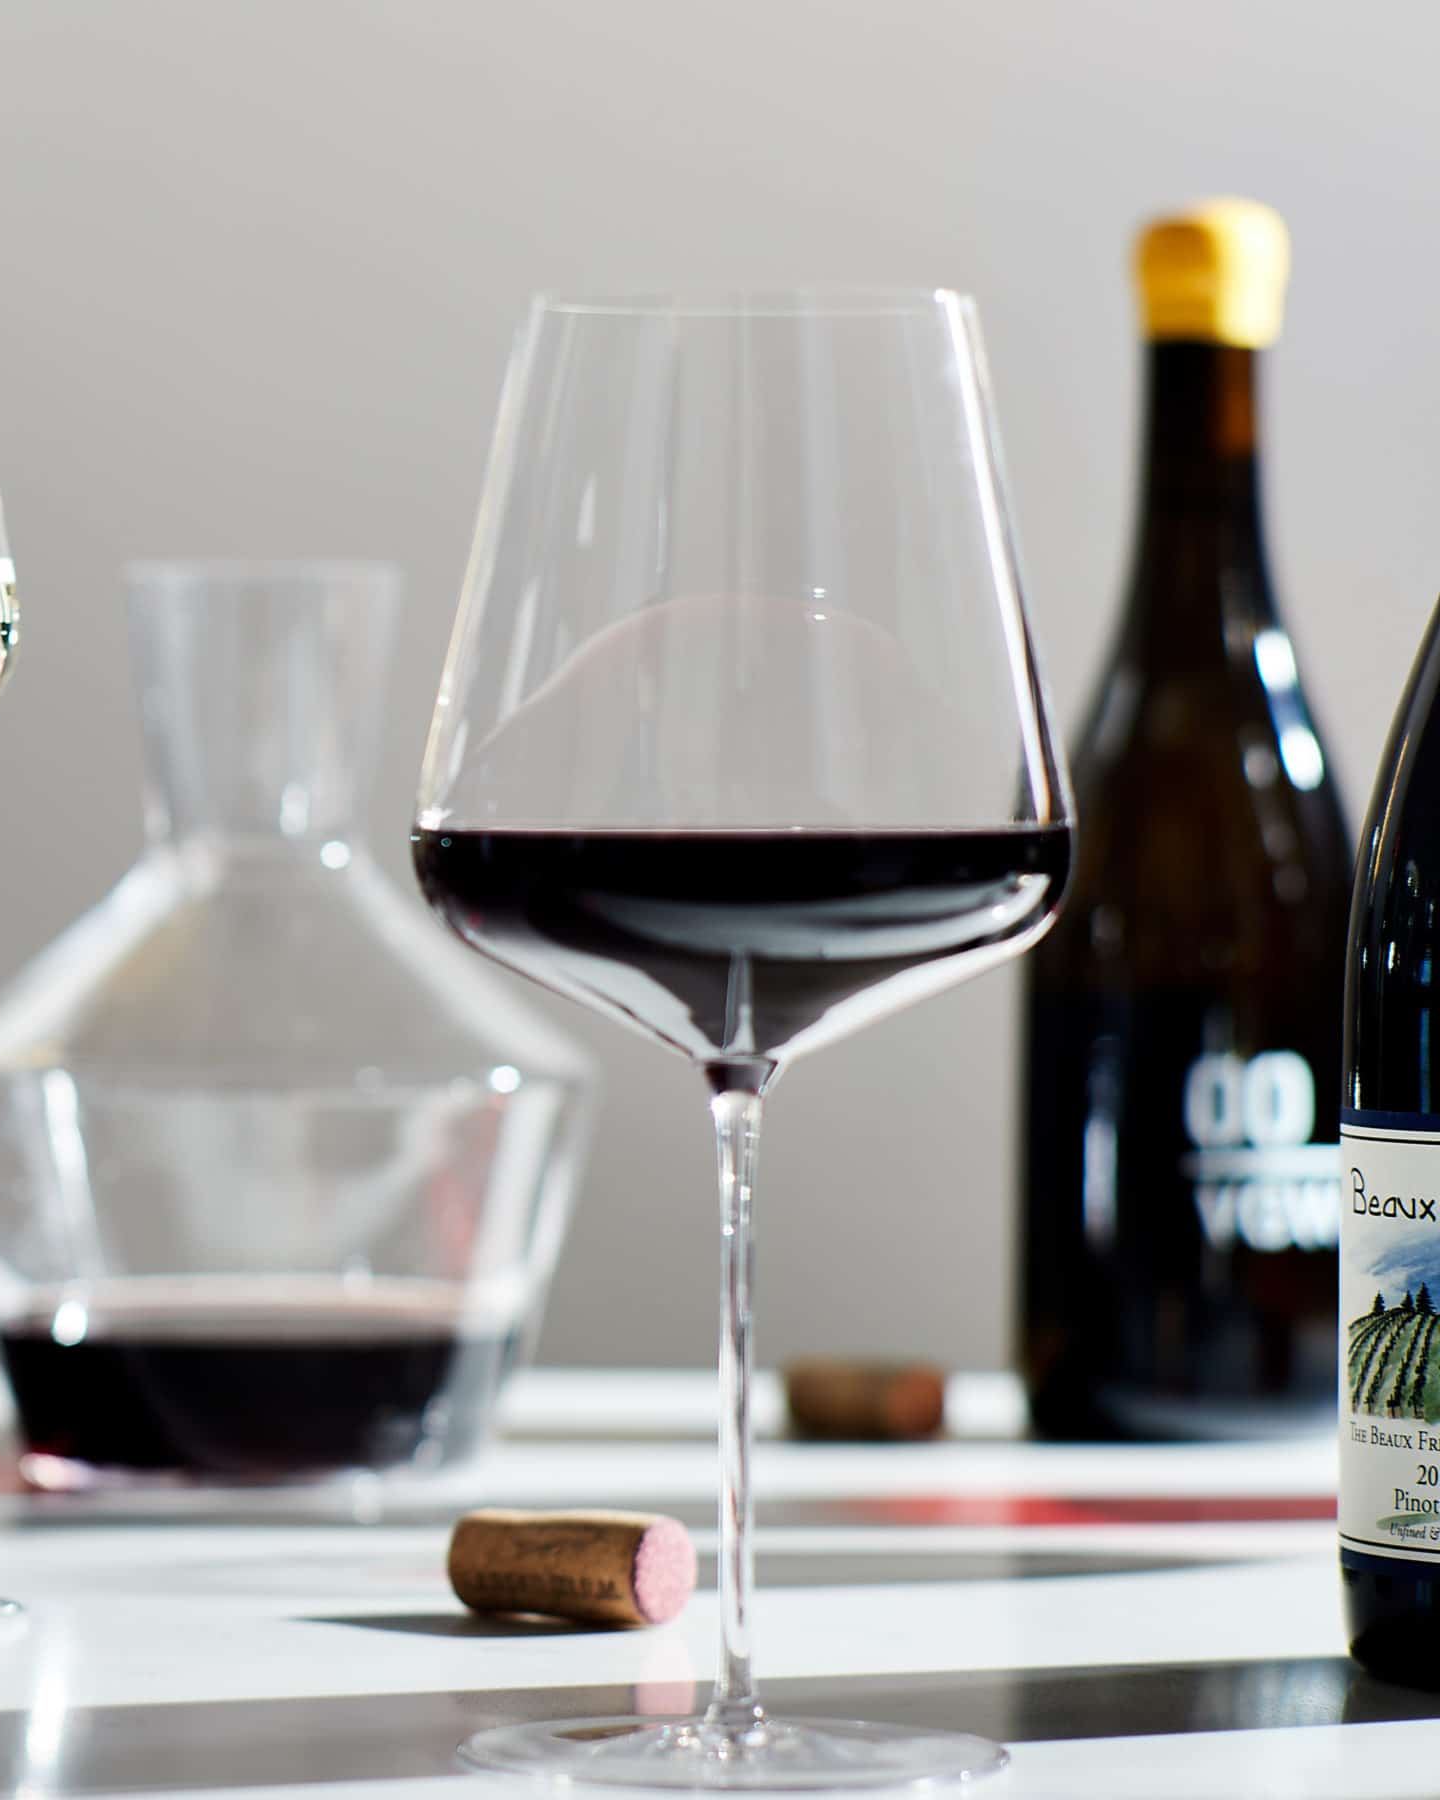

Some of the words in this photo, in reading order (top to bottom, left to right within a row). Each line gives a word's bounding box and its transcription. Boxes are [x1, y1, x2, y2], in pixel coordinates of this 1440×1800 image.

[1351, 1167, 1436, 1222] Beaux
[1370, 1425, 1412, 1449] BEAUX
[1418, 1430, 1440, 1452] FR
[1416, 1464, 1439, 1487] 20
[1394, 1488, 1440, 1514] Pinot
